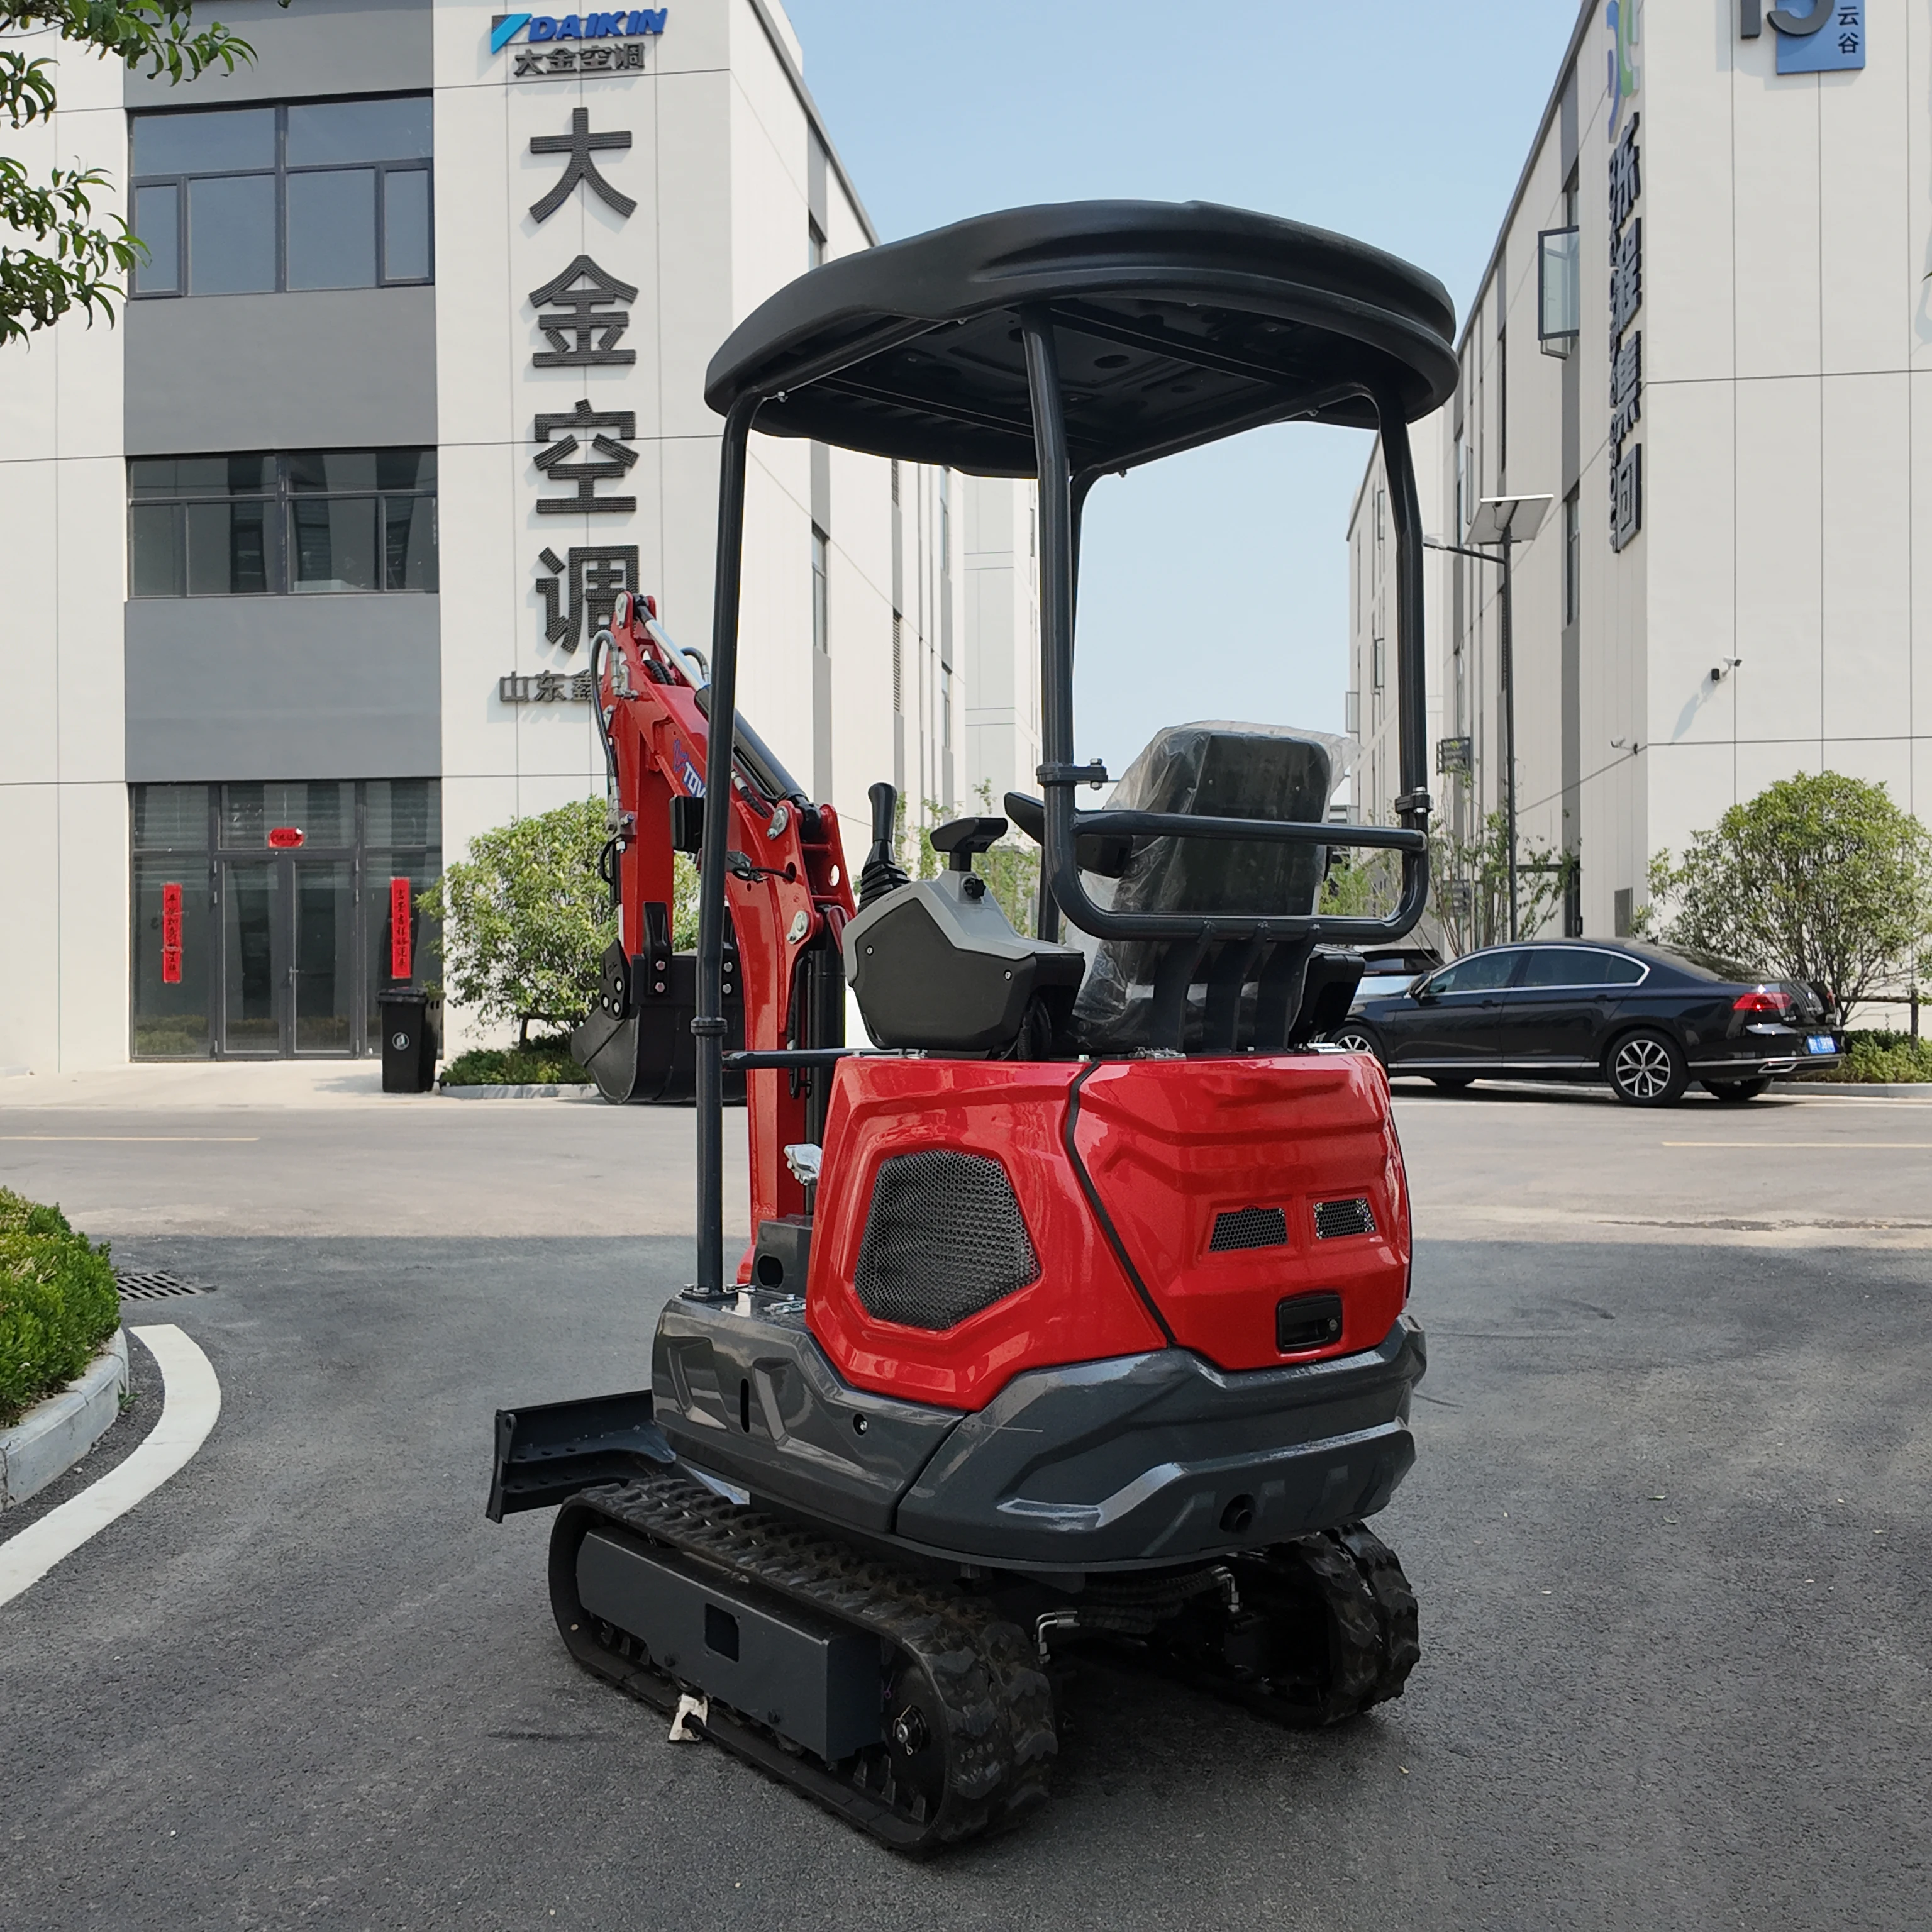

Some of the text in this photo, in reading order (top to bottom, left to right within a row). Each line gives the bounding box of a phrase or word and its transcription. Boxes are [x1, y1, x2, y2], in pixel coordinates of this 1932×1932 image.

[528, 8, 668, 42] DAIKIN
[1838, 6, 1860, 54] 云谷
[513, 43, 645, 77] 大金空调
[529, 107, 640, 654] 大金空调
[683, 760, 707, 797] TOV
